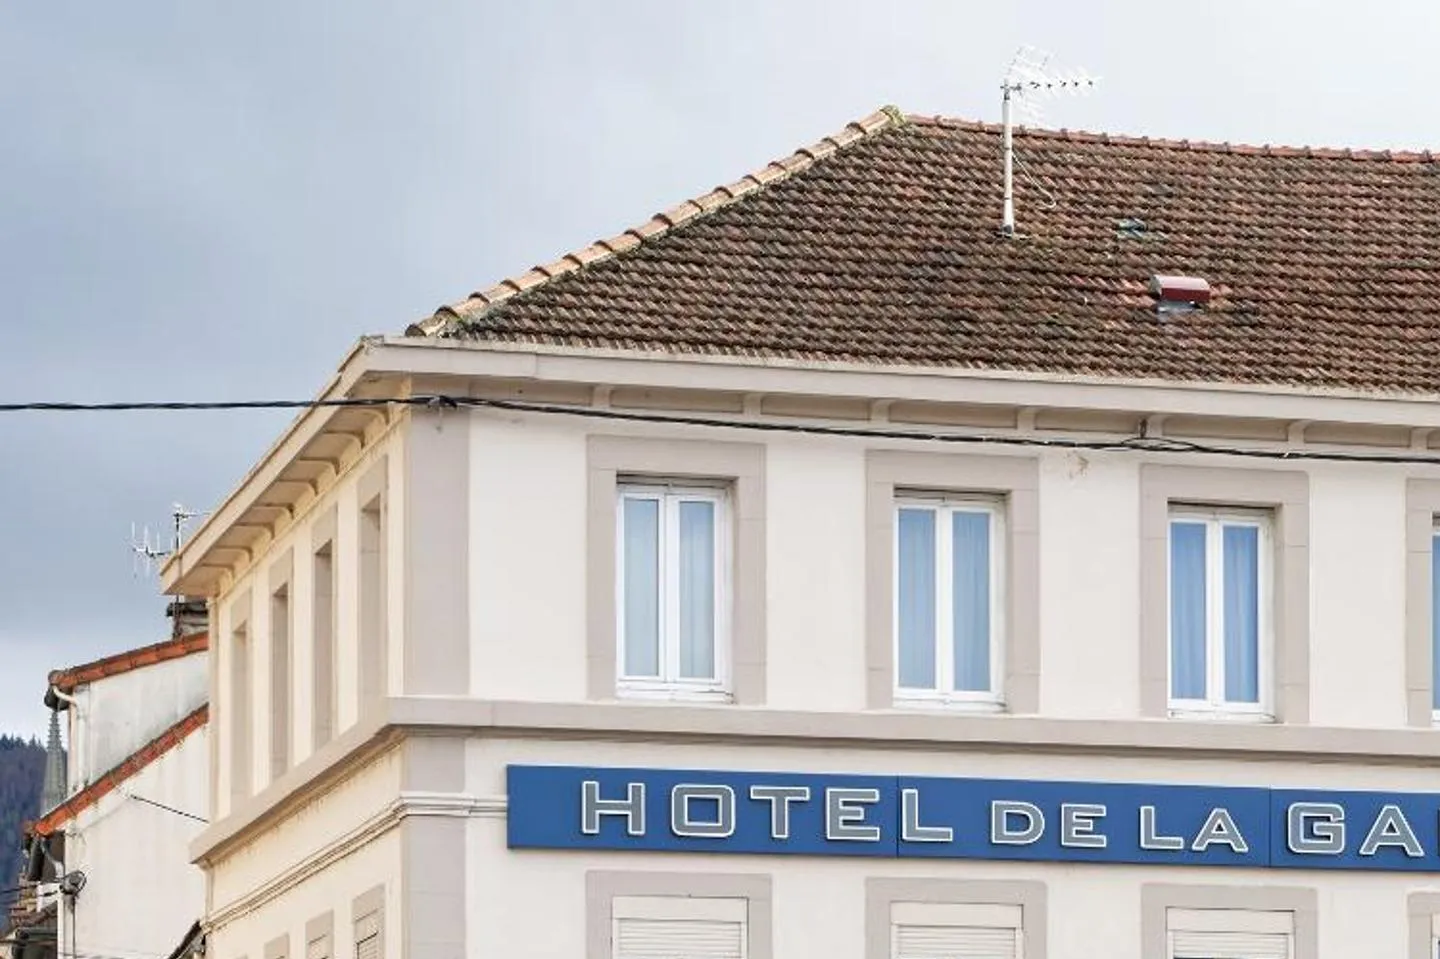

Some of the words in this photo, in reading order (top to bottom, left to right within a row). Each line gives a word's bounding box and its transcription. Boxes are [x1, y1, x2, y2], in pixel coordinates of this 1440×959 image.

[581, 780, 954, 842] HOTEL
[991, 799, 1108, 848] DE
[1139, 805, 1250, 853] LA
